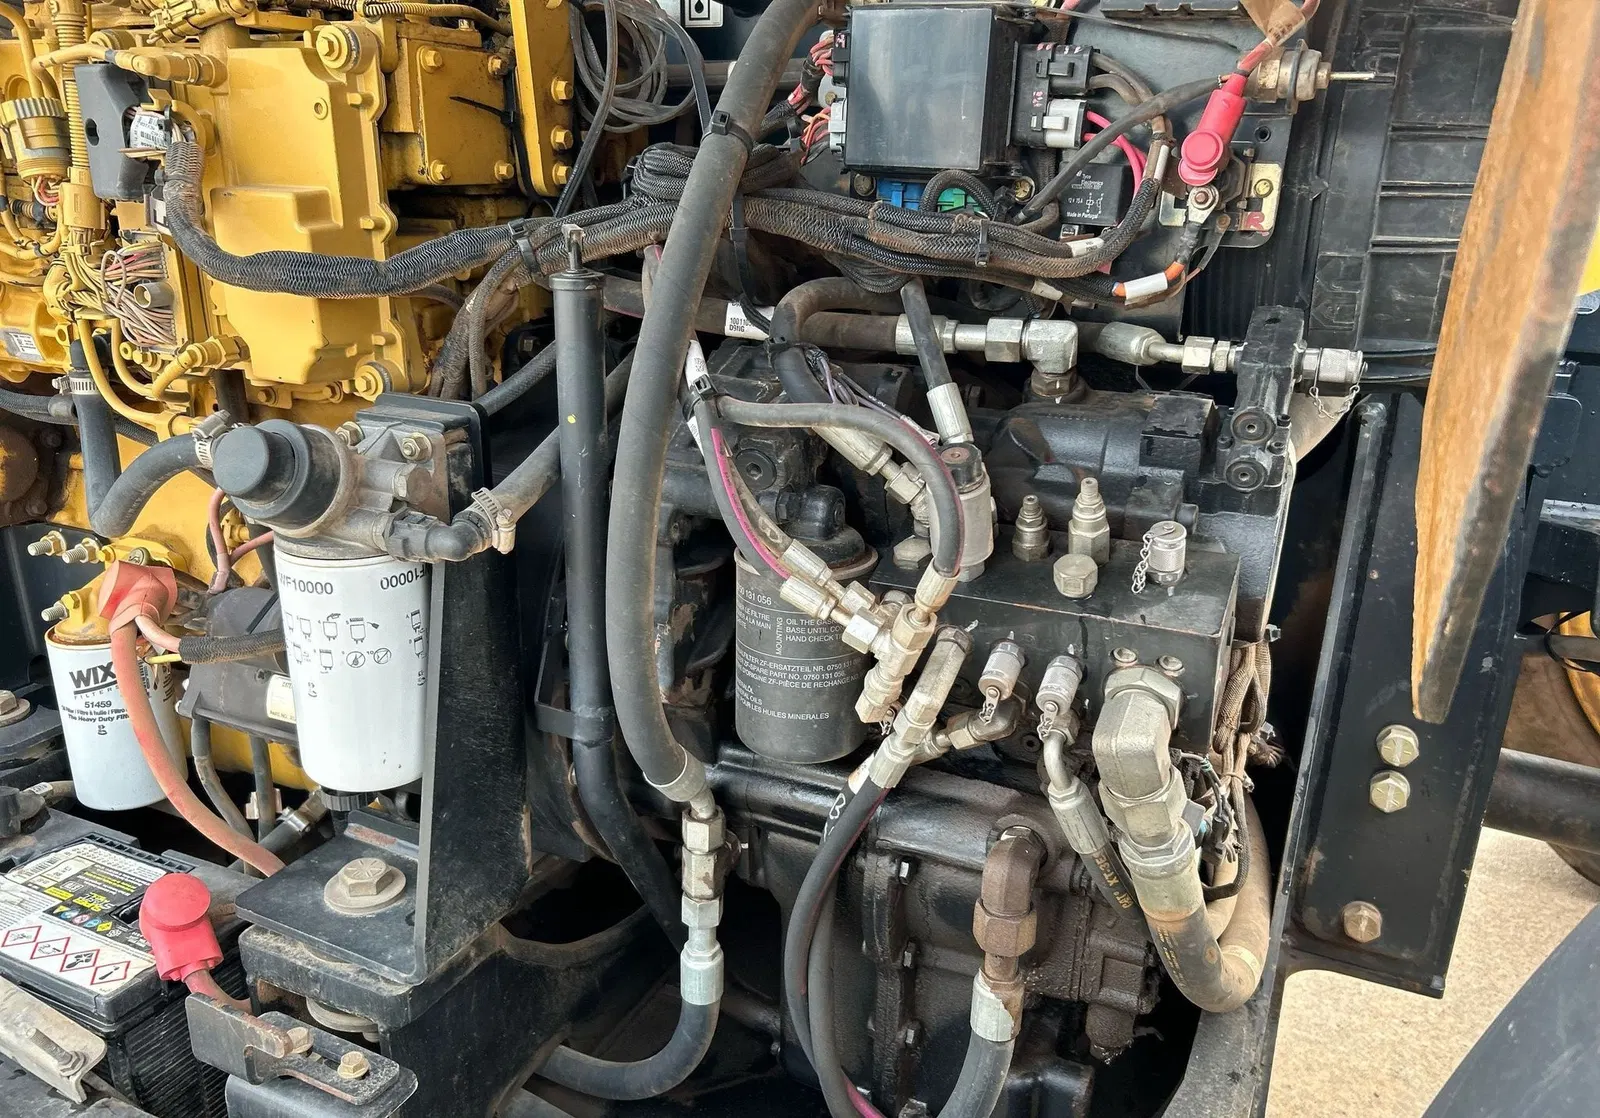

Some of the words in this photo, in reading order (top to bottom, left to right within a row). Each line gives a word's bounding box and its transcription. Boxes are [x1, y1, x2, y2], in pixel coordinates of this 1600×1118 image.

[380, 563, 427, 590] F10000
[757, 594, 772, 606] 056
[800, 618, 815, 626] THE
[775, 617, 784, 656] MOUNTING
[807, 627, 829, 635] UNTIL
[785, 635, 807, 643] HAND
[808, 634, 834, 643] CHECK
[759, 660, 812, 673] ZF-ERSATZTEIL
[812, 665, 826, 673] NR.
[827, 663, 842, 671] 0750
[69, 661, 117, 688] WIX
[769, 670, 788, 679] PART
[788, 673, 802, 681] NO.
[821, 672, 833, 680] 131
[813, 676, 850, 688] RECHANGE
[84, 700, 112, 709] 51459
[78, 715, 97, 723] Heavy
[762, 708, 787, 719] HUILES
[787, 712, 830, 720] MINERALES
